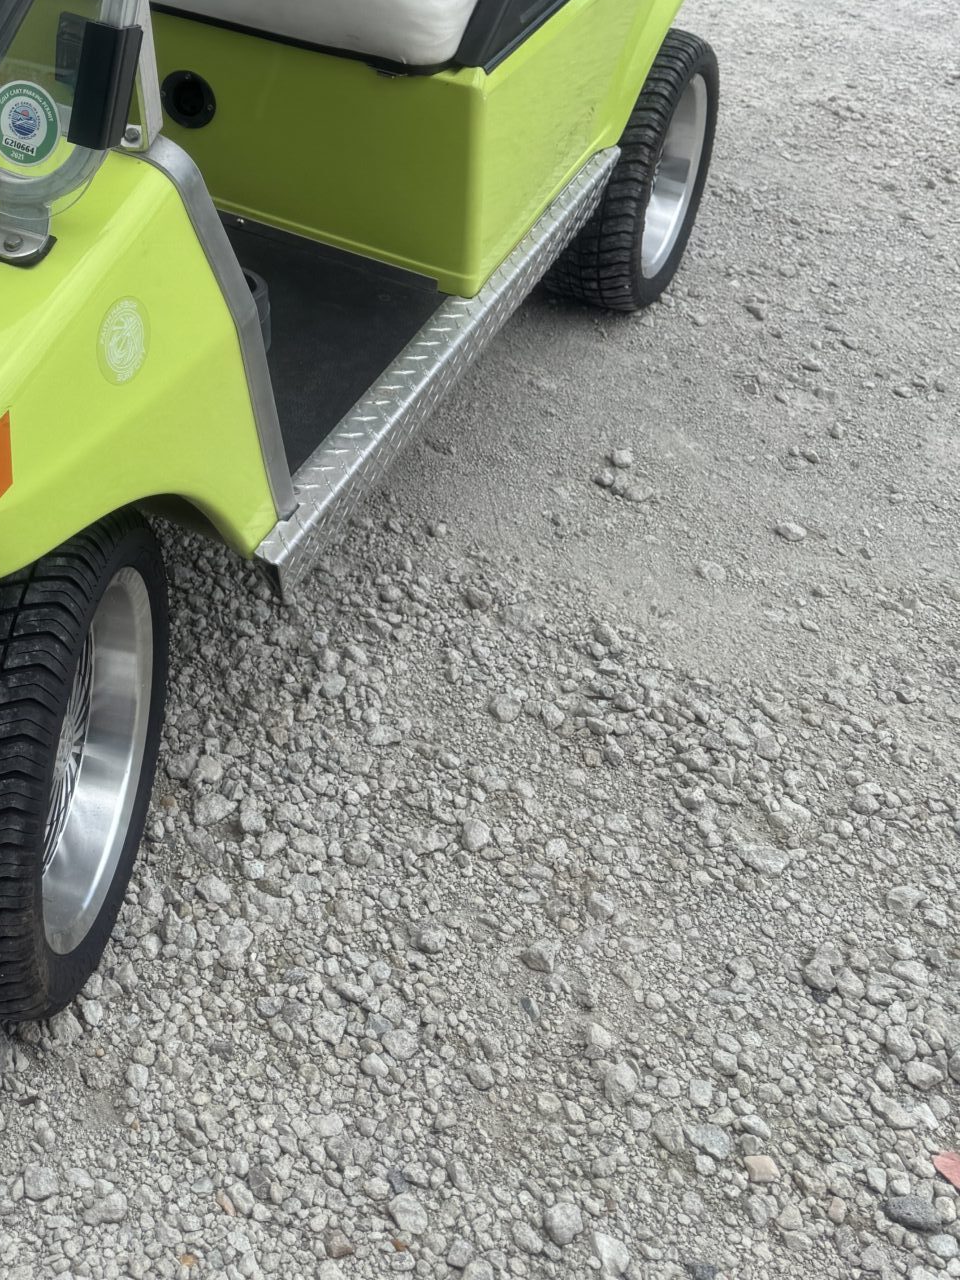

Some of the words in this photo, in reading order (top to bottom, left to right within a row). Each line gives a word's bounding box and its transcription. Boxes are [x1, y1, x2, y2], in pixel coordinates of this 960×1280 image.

[10, 88, 22, 96] CART
[23, 89, 43, 103] PARKING
[41, 101, 54, 121] PERMIT
[4, 138, 35, 154] G210664
[11, 151, 24, 160] 2021
